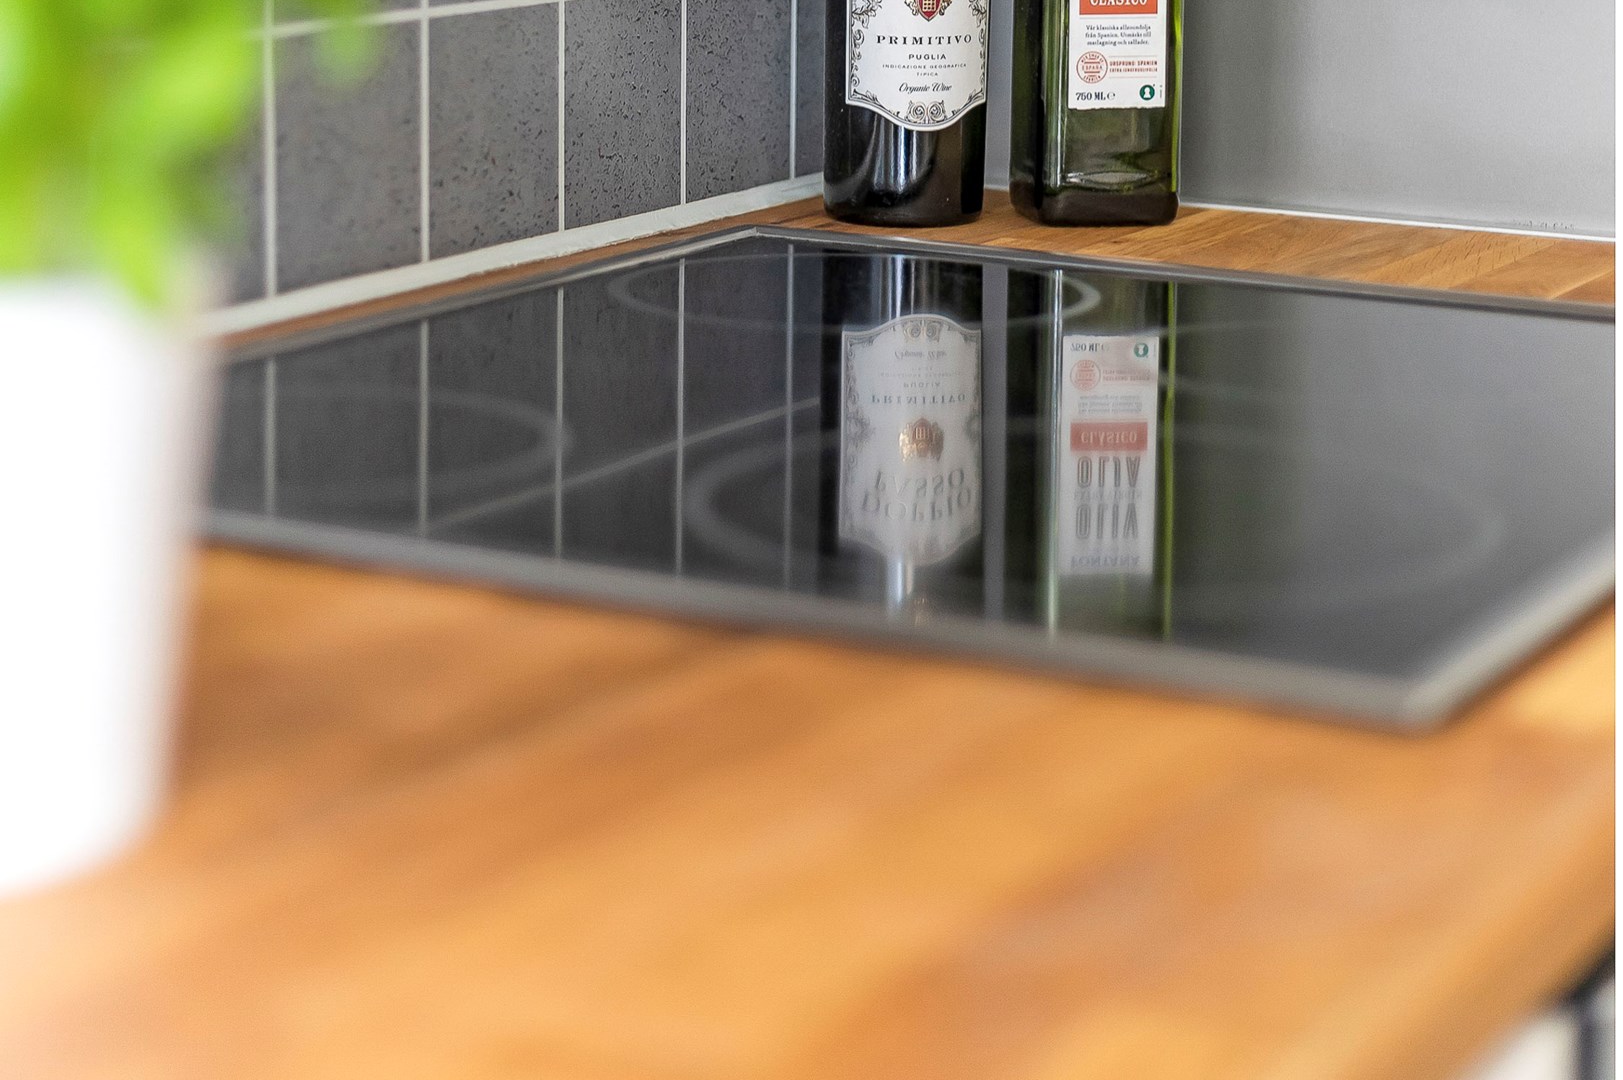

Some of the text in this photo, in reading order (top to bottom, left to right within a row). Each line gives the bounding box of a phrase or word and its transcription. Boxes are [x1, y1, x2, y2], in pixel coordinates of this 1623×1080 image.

[876, 34, 972, 45] PRIMITIVO
[908, 53, 947, 61] PUGLIA
[898, 82, 952, 94] Organic Wine
[1076, 92, 1092, 101] 750
[1094, 91, 1106, 100] ML
